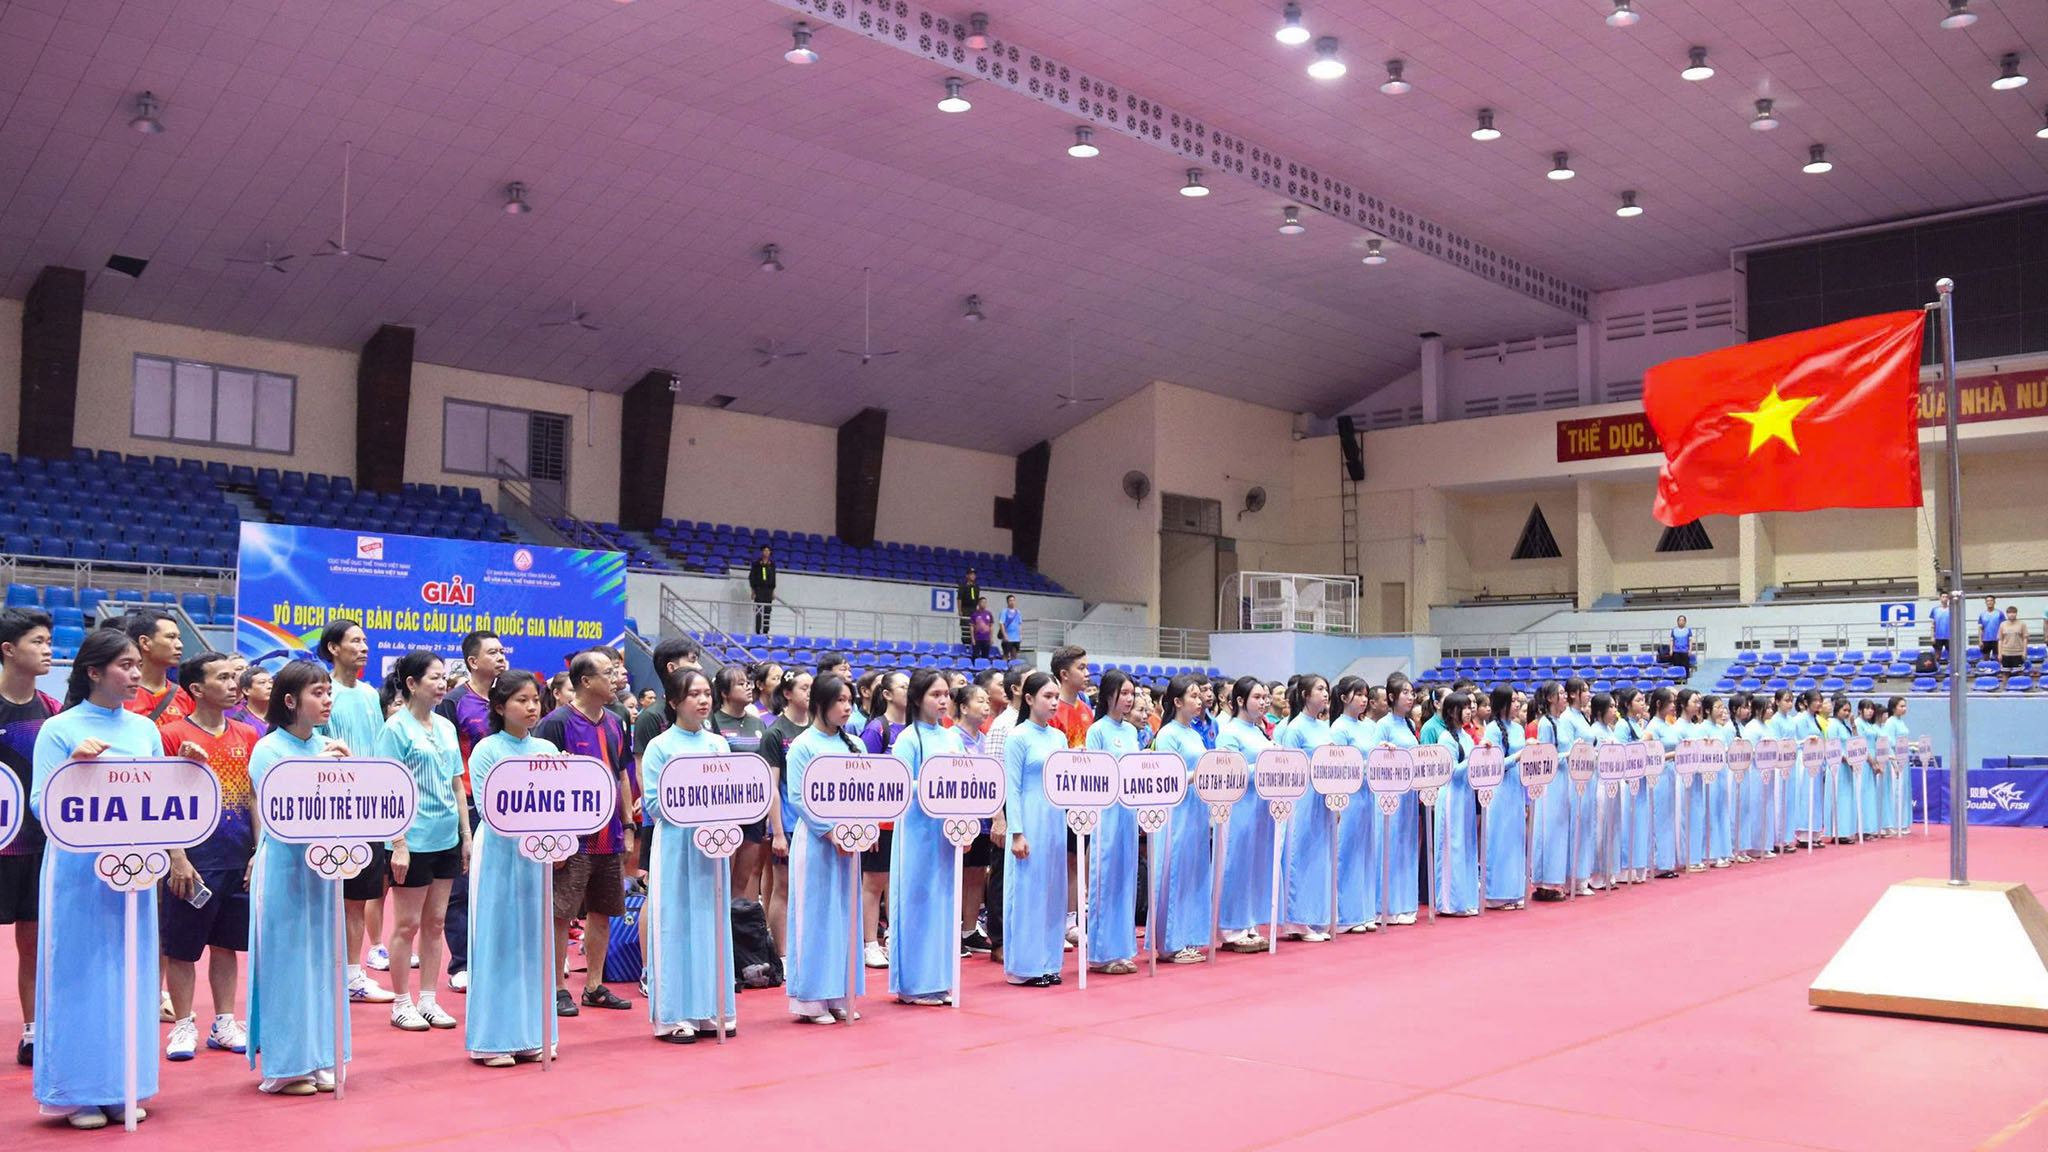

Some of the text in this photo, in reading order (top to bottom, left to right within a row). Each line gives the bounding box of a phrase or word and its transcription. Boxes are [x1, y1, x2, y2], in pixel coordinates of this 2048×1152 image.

[1918, 386, 1946, 419] ỦA
[1961, 381, 2007, 415] NHÀ
[422, 575, 475, 606] GIẢI
[936, 590, 951, 609] B
[273, 600, 291, 625] VÔ
[294, 605, 325, 630] ĐỊCH
[395, 608, 419, 632] CÁC
[423, 609, 447, 632] CÂU
[450, 613, 472, 638] LẠC
[494, 611, 524, 637] QUỐC
[527, 617, 545, 637] GIA
[548, 616, 574, 638] NĂM
[577, 621, 602, 640] 2026
[1889, 604, 1909, 625] C
[702, 760, 731, 774] ĐOÀN
[845, 756, 872, 769] ĐOÀN
[952, 756, 974, 768] ĐOÀN
[1522, 757, 1553, 779] TRỌNG TÀI
[108, 767, 152, 784] ĐOÀN
[317, 768, 356, 783] ĐOÀN
[928, 773, 997, 800] LÂM ĐỒNG
[1056, 770, 1109, 793] TÂY NINH
[1123, 775, 1178, 799] LẠNG SƠN
[1198, 774, 1209, 790] CLB
[1210, 774, 1223, 790] T&H
[496, 782, 601, 817] QUẢNG TRỊ
[666, 776, 765, 808] CLB ĐKQ KHÁNH HÒA
[811, 777, 904, 802] CLB ĐÔNG ANH
[60, 796, 199, 823] GIA LAI
[270, 785, 405, 821] CLB TUỔI TRẺ TUY HÒA
